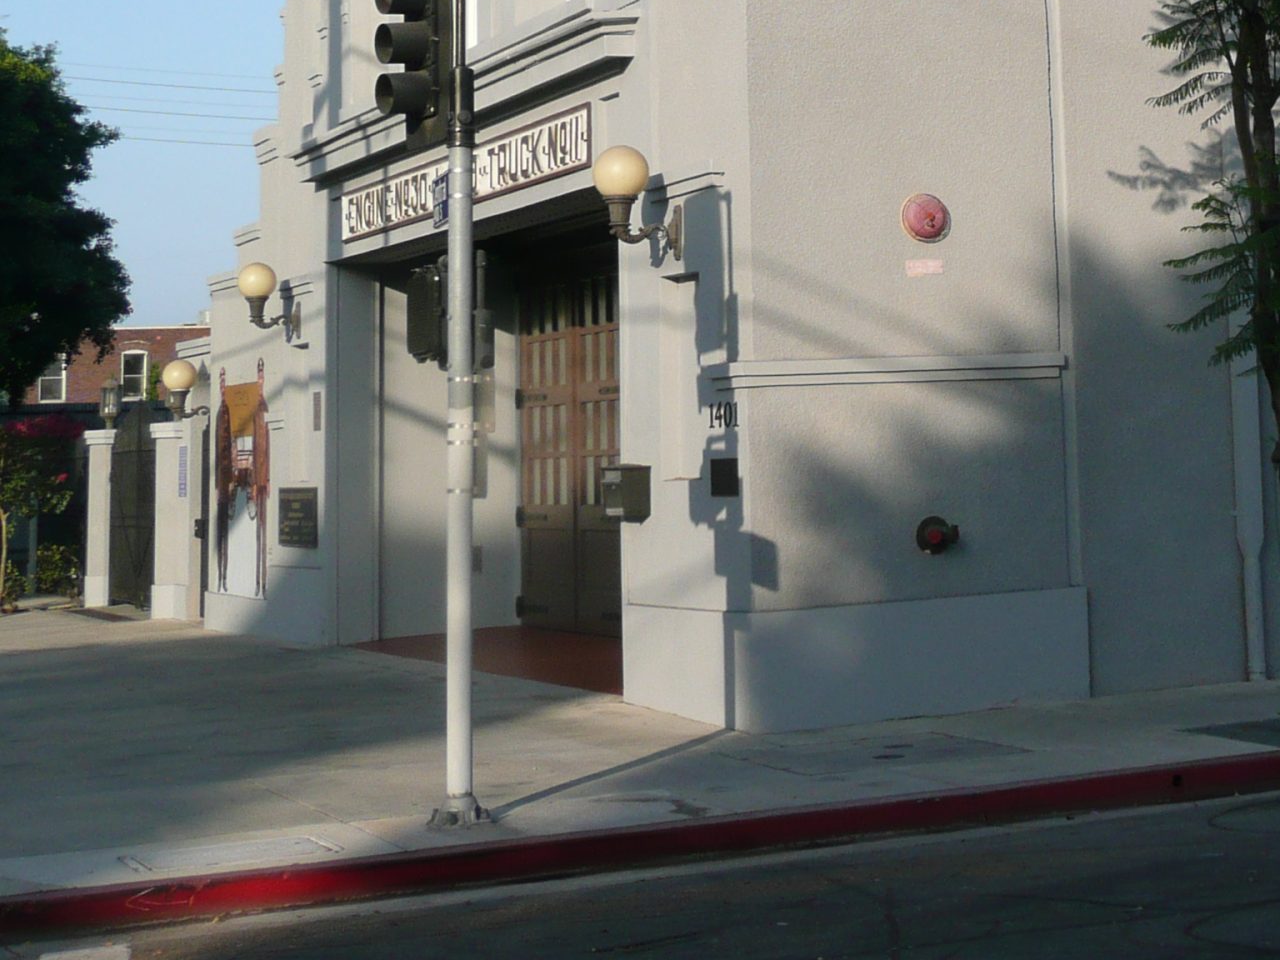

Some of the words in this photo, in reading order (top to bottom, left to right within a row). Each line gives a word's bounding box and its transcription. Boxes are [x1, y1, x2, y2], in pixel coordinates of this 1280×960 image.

[348, 185, 393, 233] ENGINE
[487, 129, 544, 190] TRUCK
[709, 401, 740, 429] 1401
